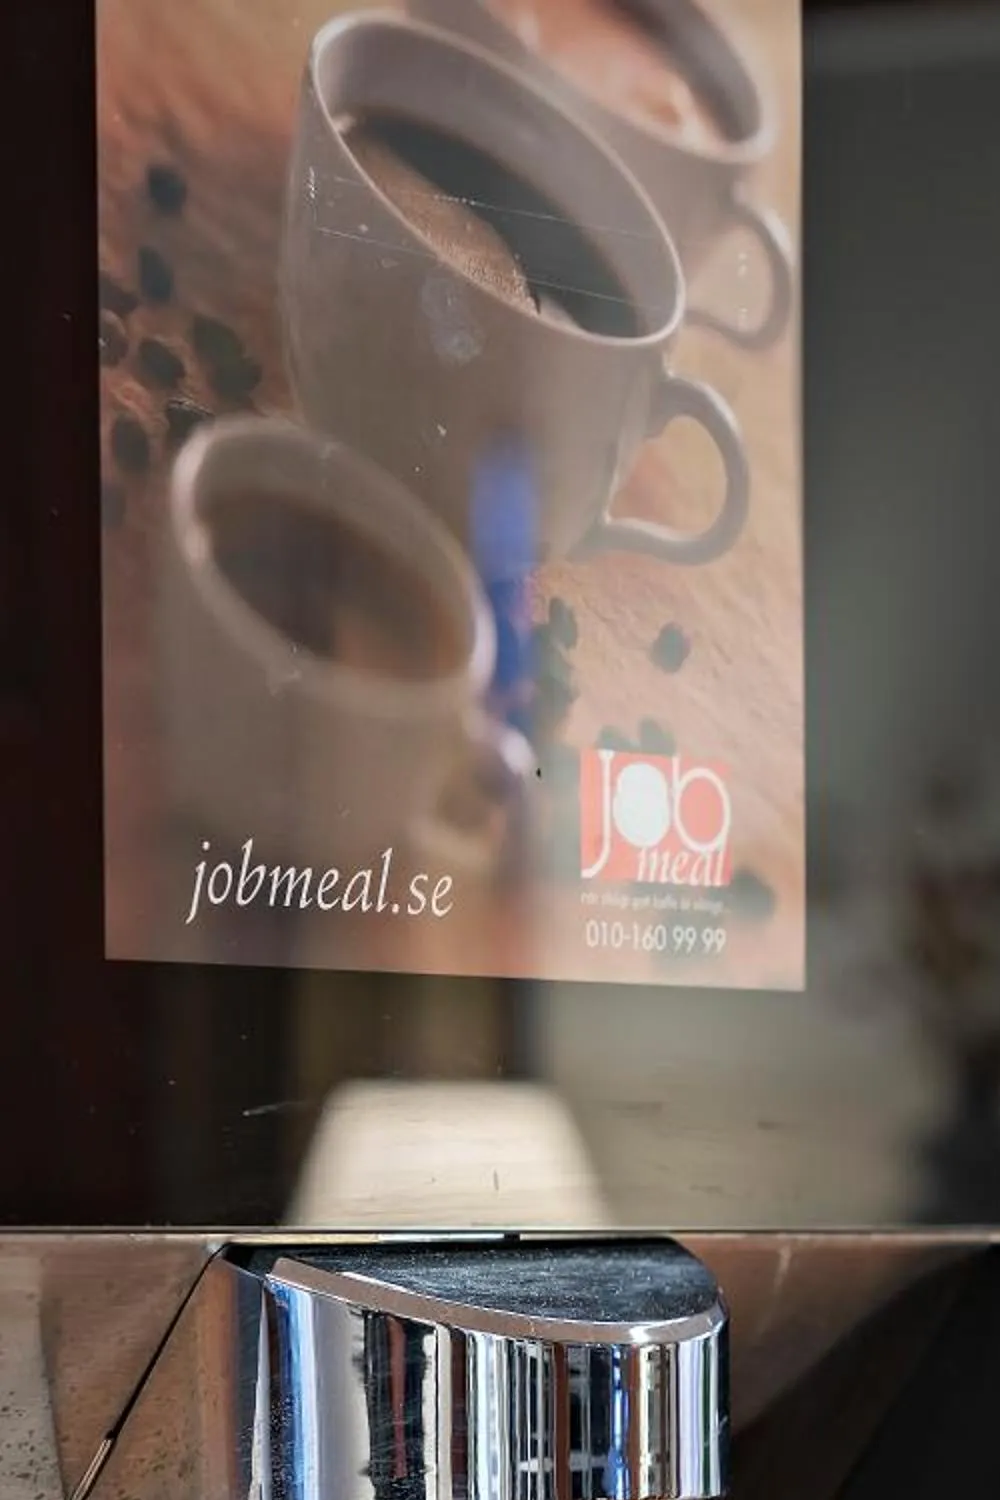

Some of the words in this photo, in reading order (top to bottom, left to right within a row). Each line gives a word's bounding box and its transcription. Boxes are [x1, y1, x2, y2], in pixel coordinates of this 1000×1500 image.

[184, 838, 454, 925] jobmeal.se
[636, 847, 727, 887] meal
[586, 919, 667, 951] 010-160
[672, 924, 697, 953] 99
[702, 927, 727, 953] 99
